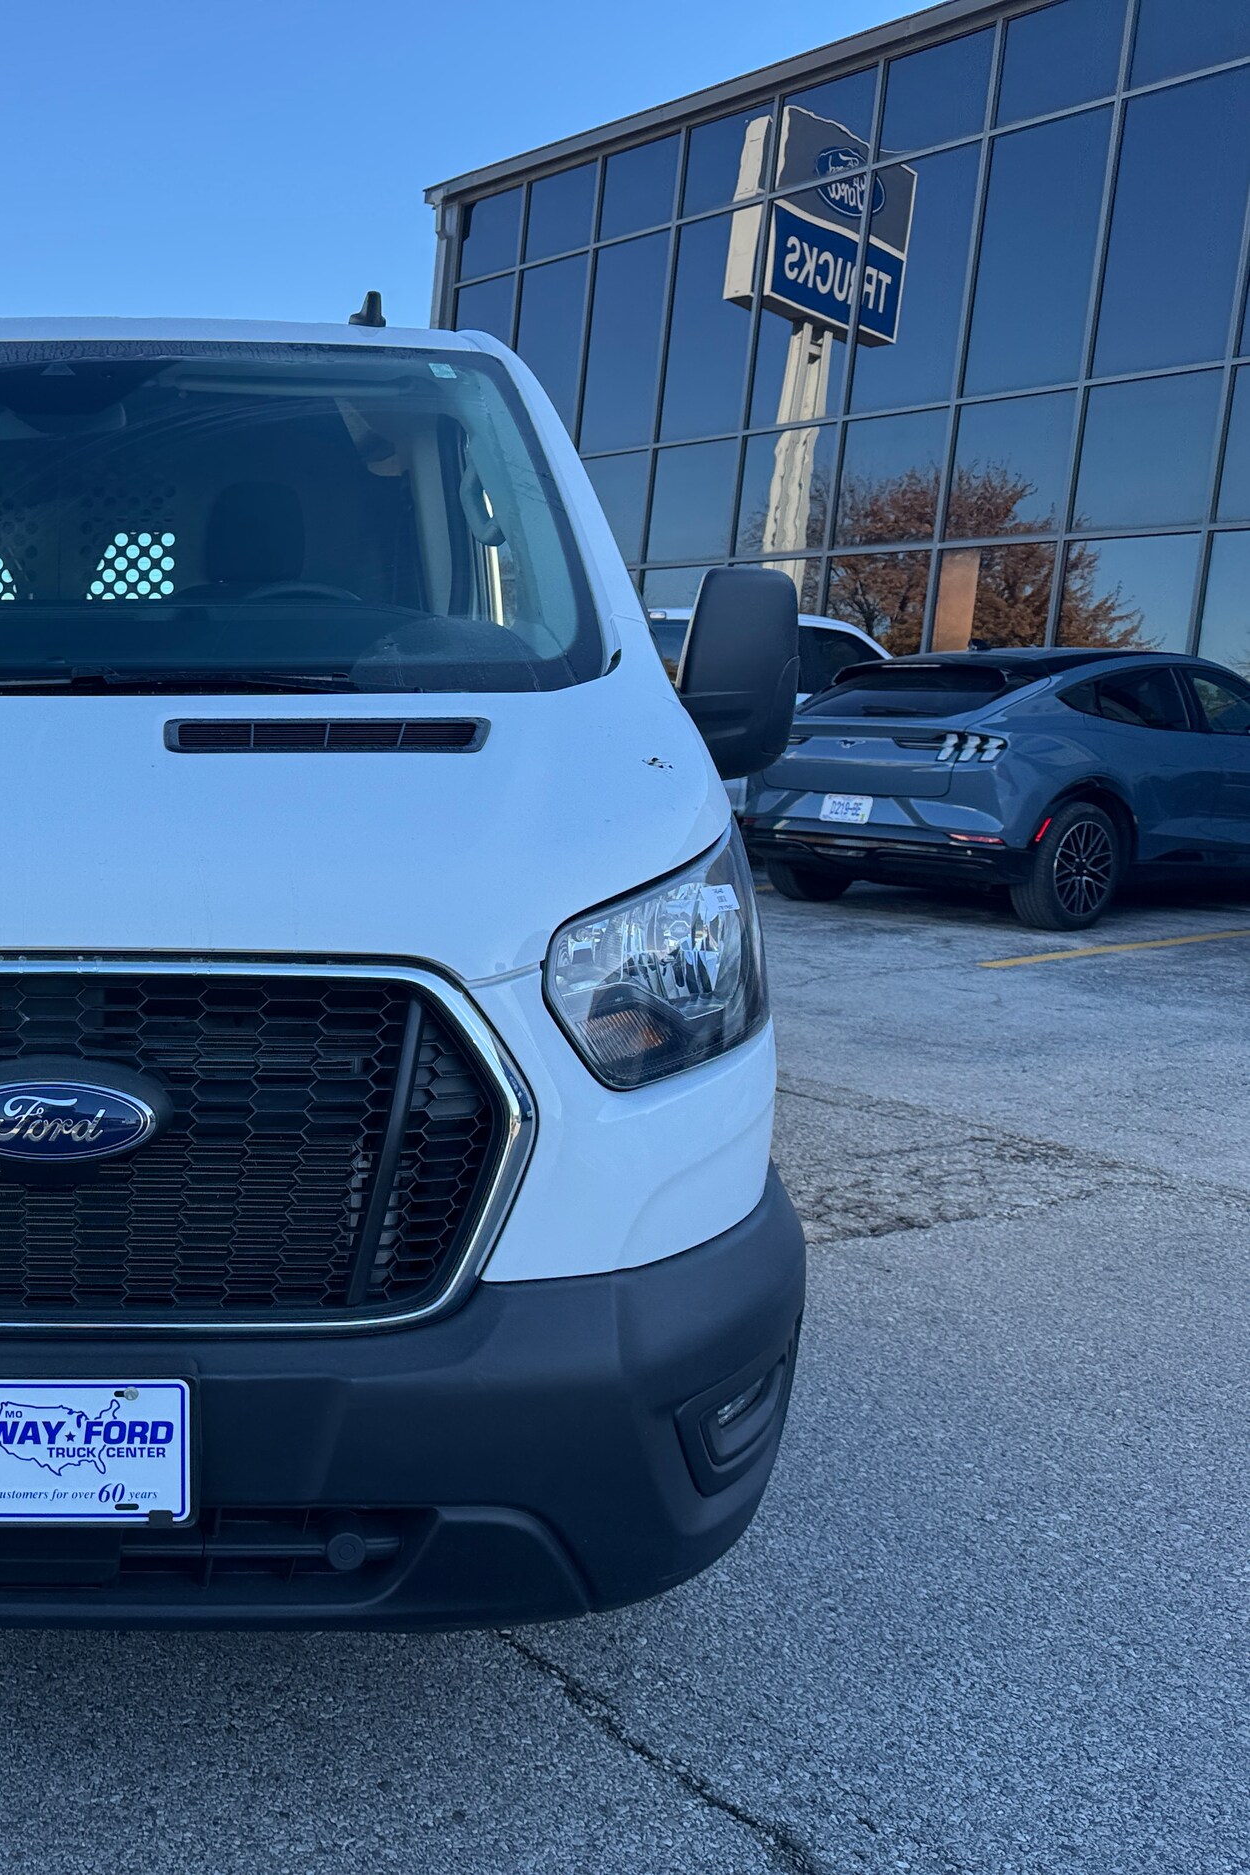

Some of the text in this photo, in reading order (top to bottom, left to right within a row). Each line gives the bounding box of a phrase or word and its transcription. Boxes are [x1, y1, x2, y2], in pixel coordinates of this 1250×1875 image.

[5, 1409, 23, 1418] MO
[83, 1420, 175, 1445] FORD
[47, 1447, 166, 1459] TRUCK CENTER
[50, 1487, 70, 1502] for
[71, 1491, 96, 1500] over
[98, 1482, 126, 1503] 60
[128, 1491, 159, 1502] years
